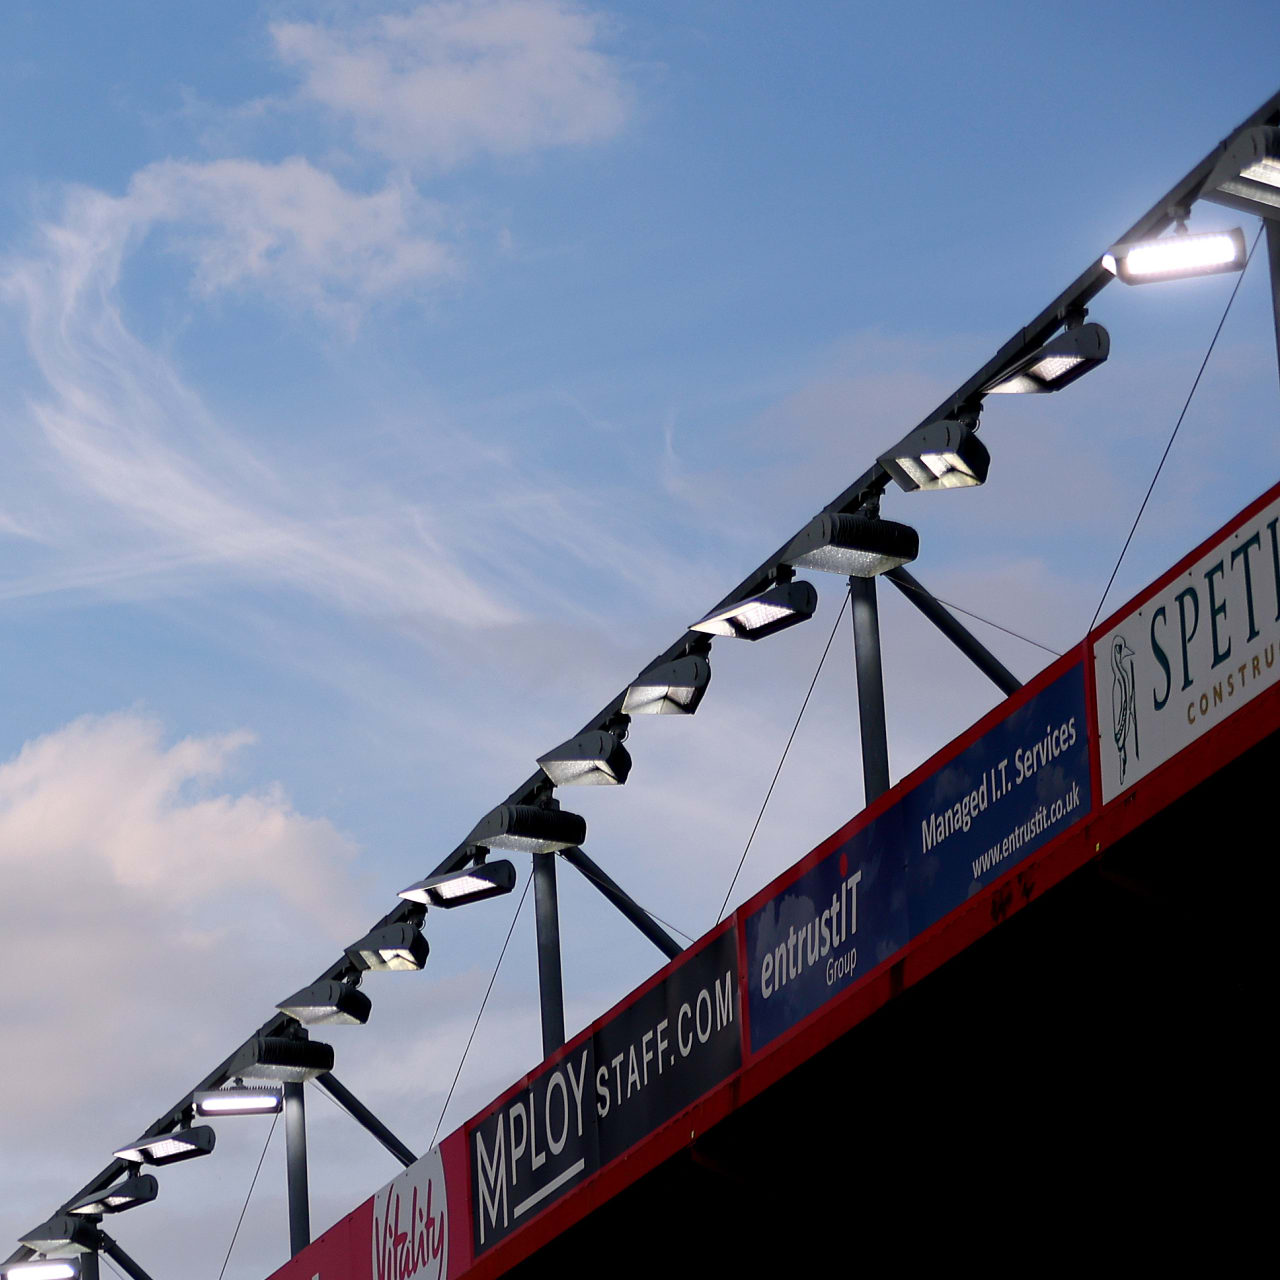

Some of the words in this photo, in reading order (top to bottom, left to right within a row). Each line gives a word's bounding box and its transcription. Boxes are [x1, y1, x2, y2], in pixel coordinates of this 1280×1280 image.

[921, 773, 988, 853] Managed
[991, 759, 1012, 803] I.T.
[1015, 717, 1076, 785] Services
[972, 781, 1080, 879] www.entrustit.co.uk
[825, 947, 857, 987] Group
[475, 1050, 588, 1245] MPLOY
[596, 971, 733, 1119] STAFF.COM
